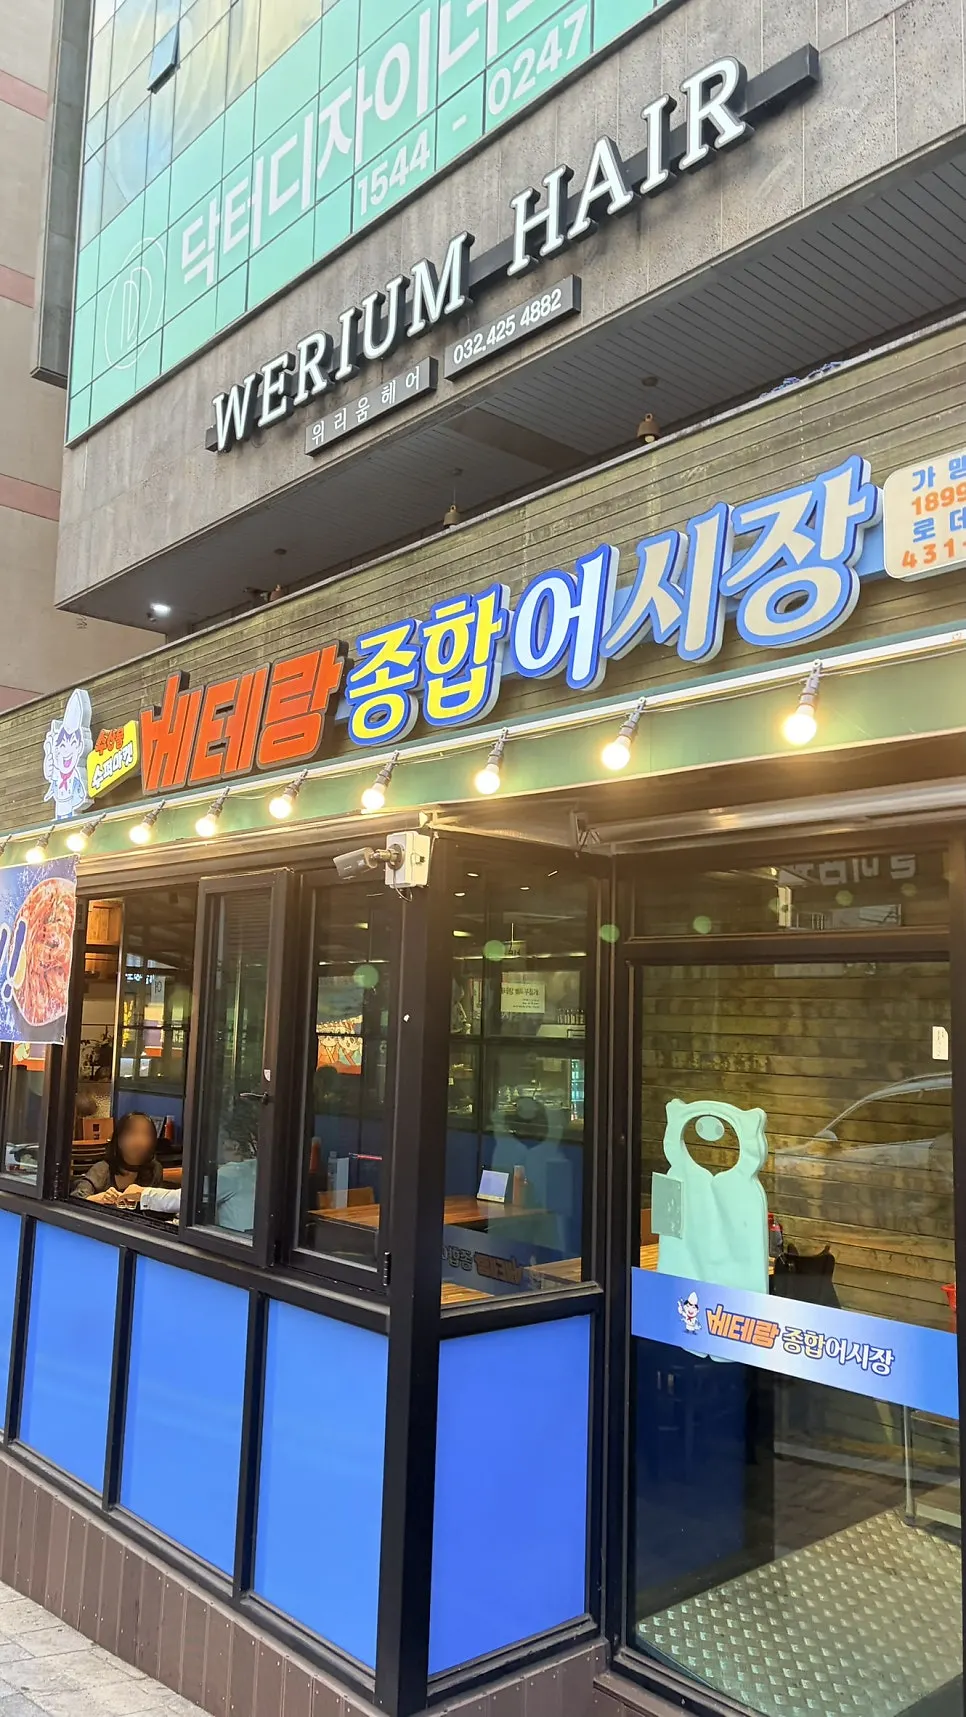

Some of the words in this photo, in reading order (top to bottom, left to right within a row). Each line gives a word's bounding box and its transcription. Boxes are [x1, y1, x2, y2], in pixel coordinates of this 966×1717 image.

[181, 0, 536, 287] 닥터디자이너
[357, 129, 430, 216] 1544
[488, 4, 588, 116] 0247
[211, 231, 472, 453] WERIUM
[507, 55, 748, 277] HAIR
[519, 288, 562, 327] 4882
[140, 642, 346, 794] 베테랑
[705, 1303, 781, 1349] 베테랑
[782, 1326, 896, 1377] 종합어시장
